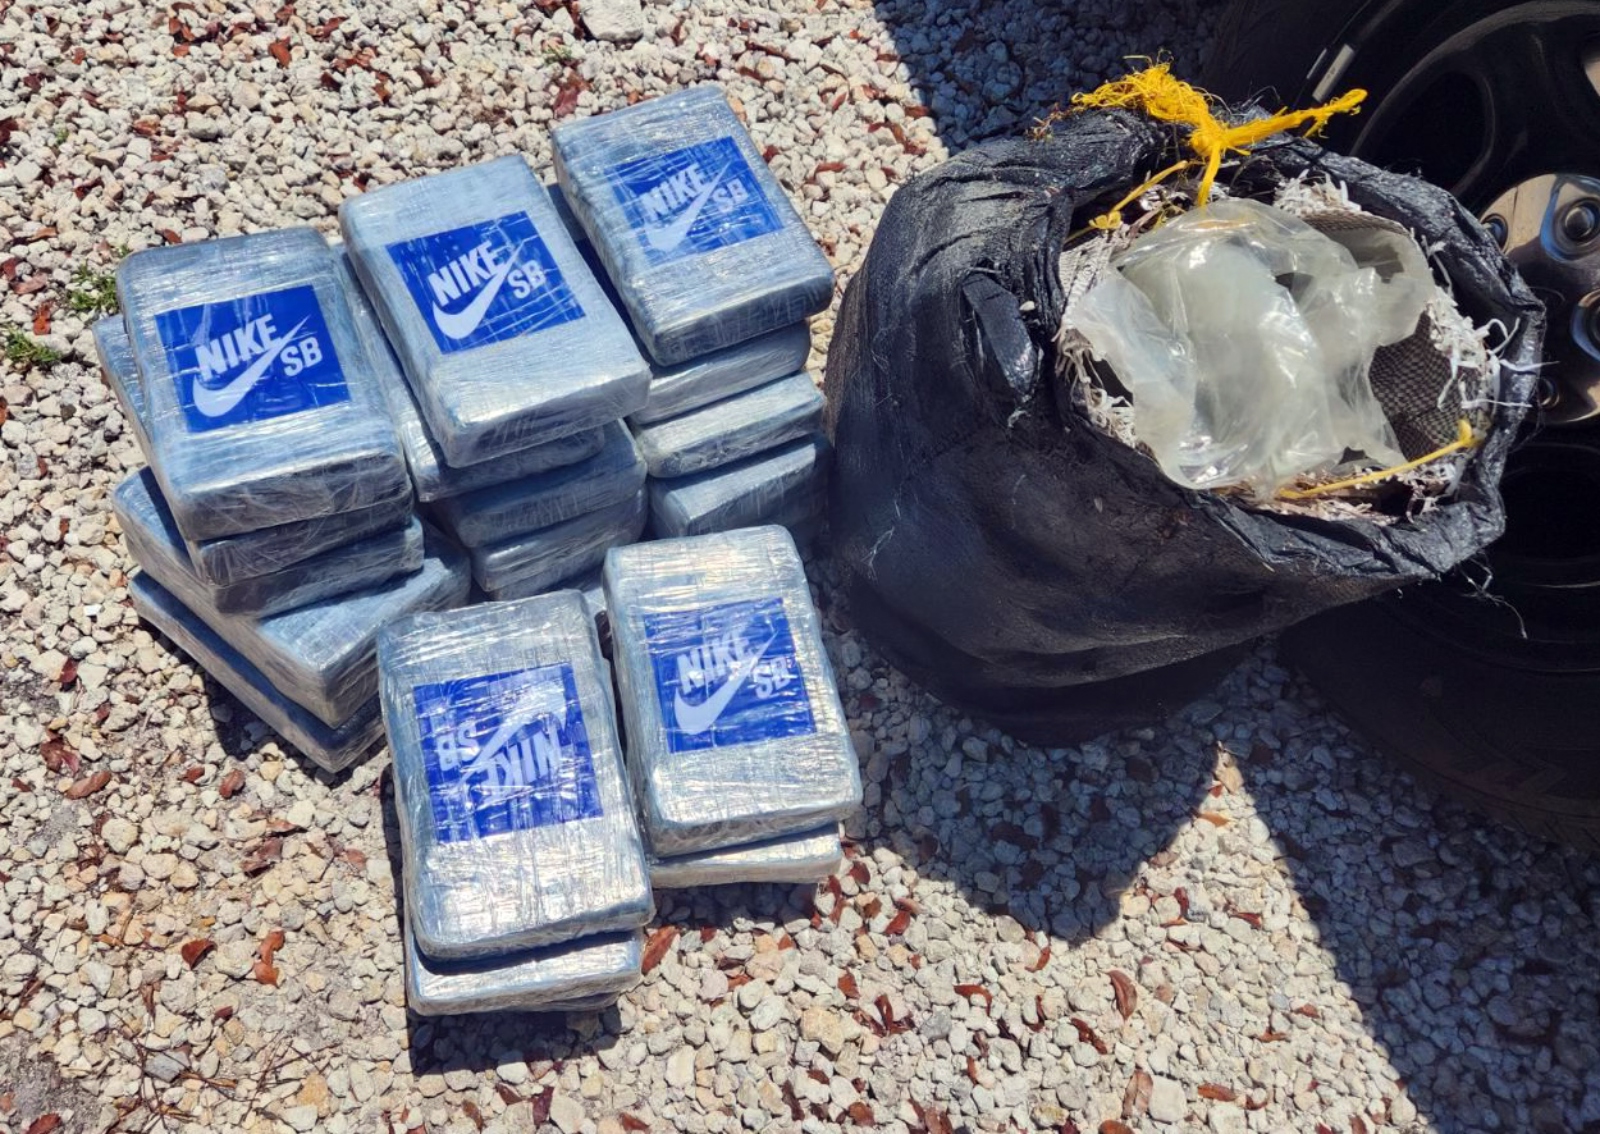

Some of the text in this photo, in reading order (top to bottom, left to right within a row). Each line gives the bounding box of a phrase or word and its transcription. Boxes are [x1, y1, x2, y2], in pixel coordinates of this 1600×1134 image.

[639, 162, 749, 221] NIKE SB
[428, 240, 546, 307] NIKE SB
[195, 313, 323, 381] NIKE SB
[677, 628, 791, 700] NIKE SB
[436, 721, 563, 806] NIKE SB
